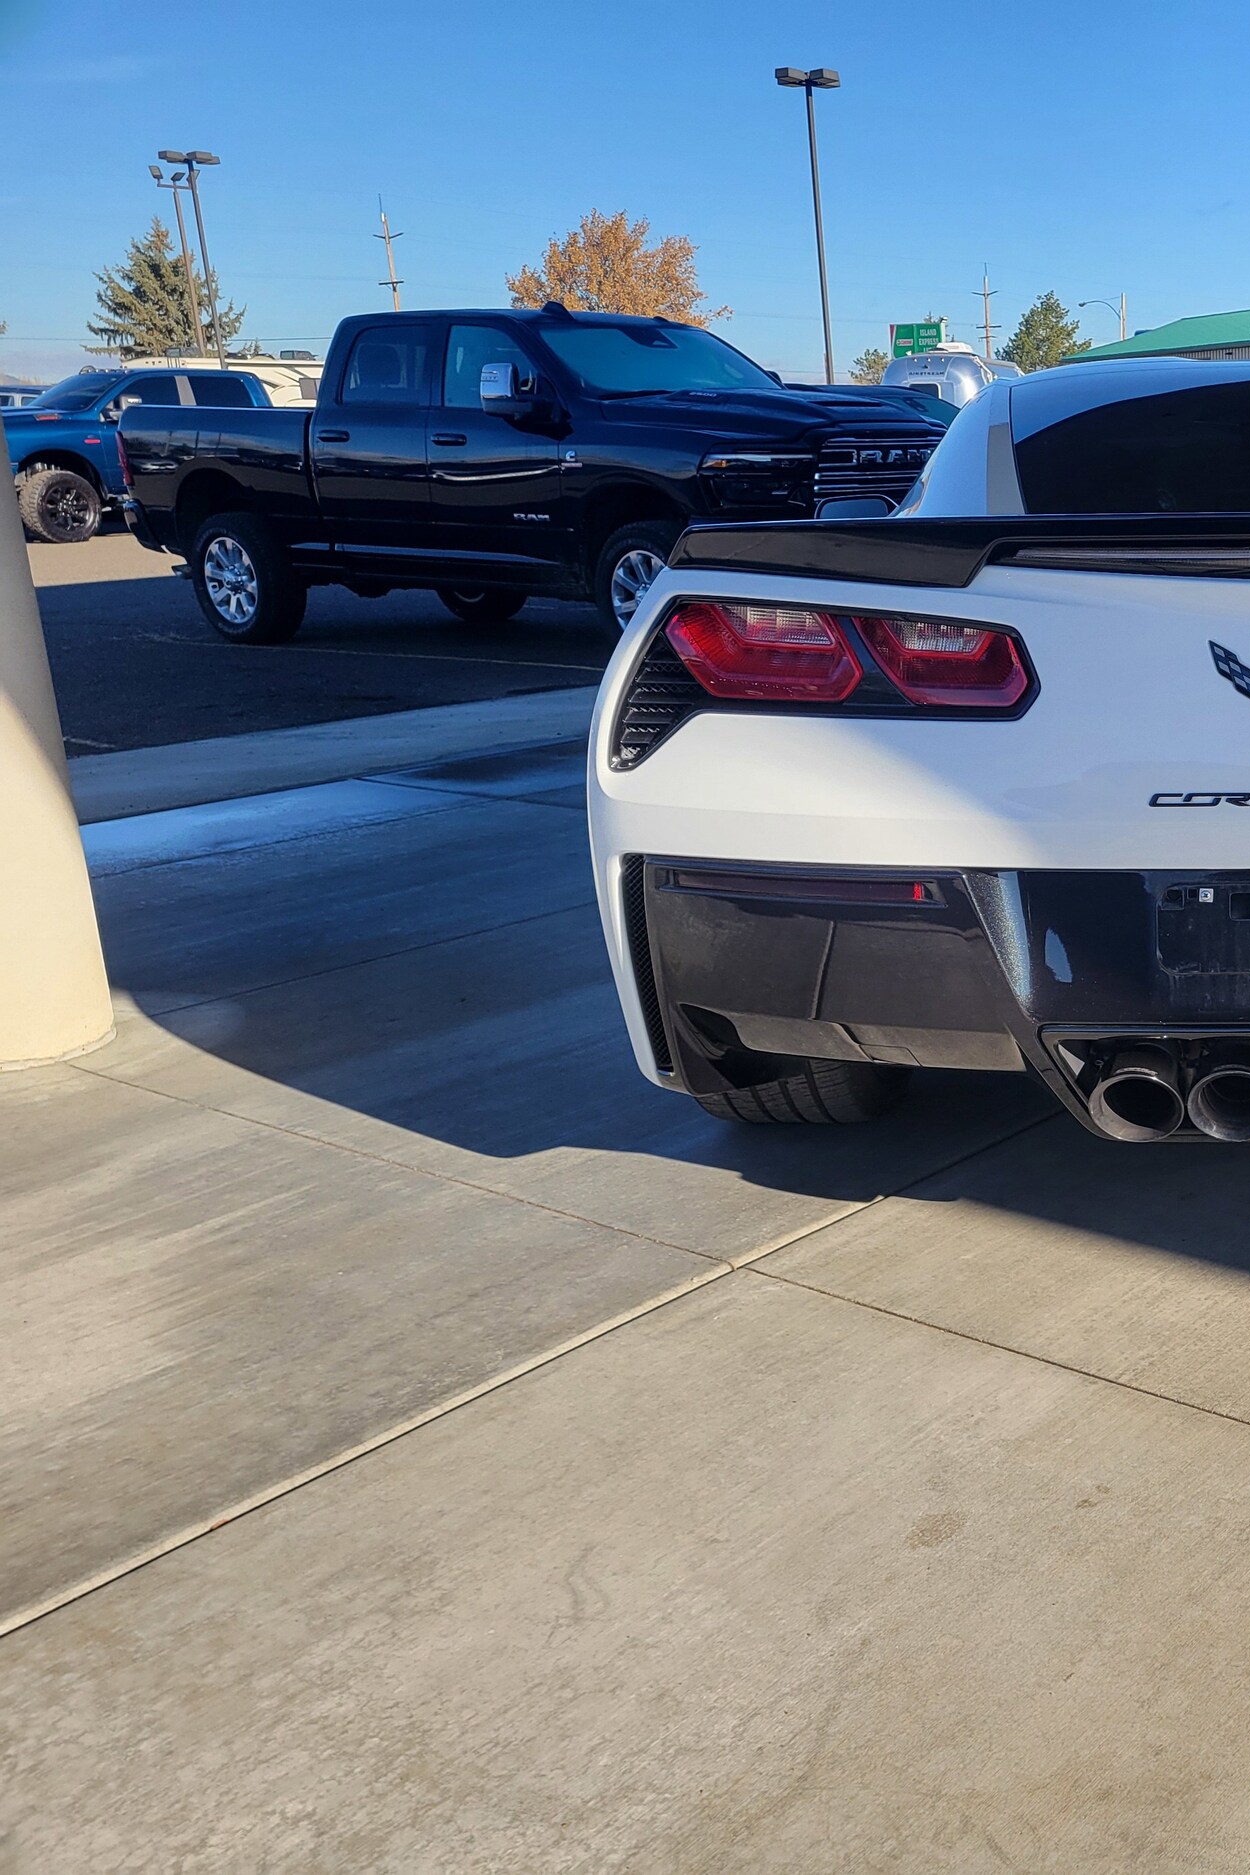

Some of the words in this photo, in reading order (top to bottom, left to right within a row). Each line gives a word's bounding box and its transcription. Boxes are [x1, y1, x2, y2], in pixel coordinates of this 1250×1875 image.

[919, 328, 937, 336] ISLAND
[918, 337, 939, 346] EXPRESS
[859, 448, 931, 464] RAM
[513, 512, 550, 522] RAM
